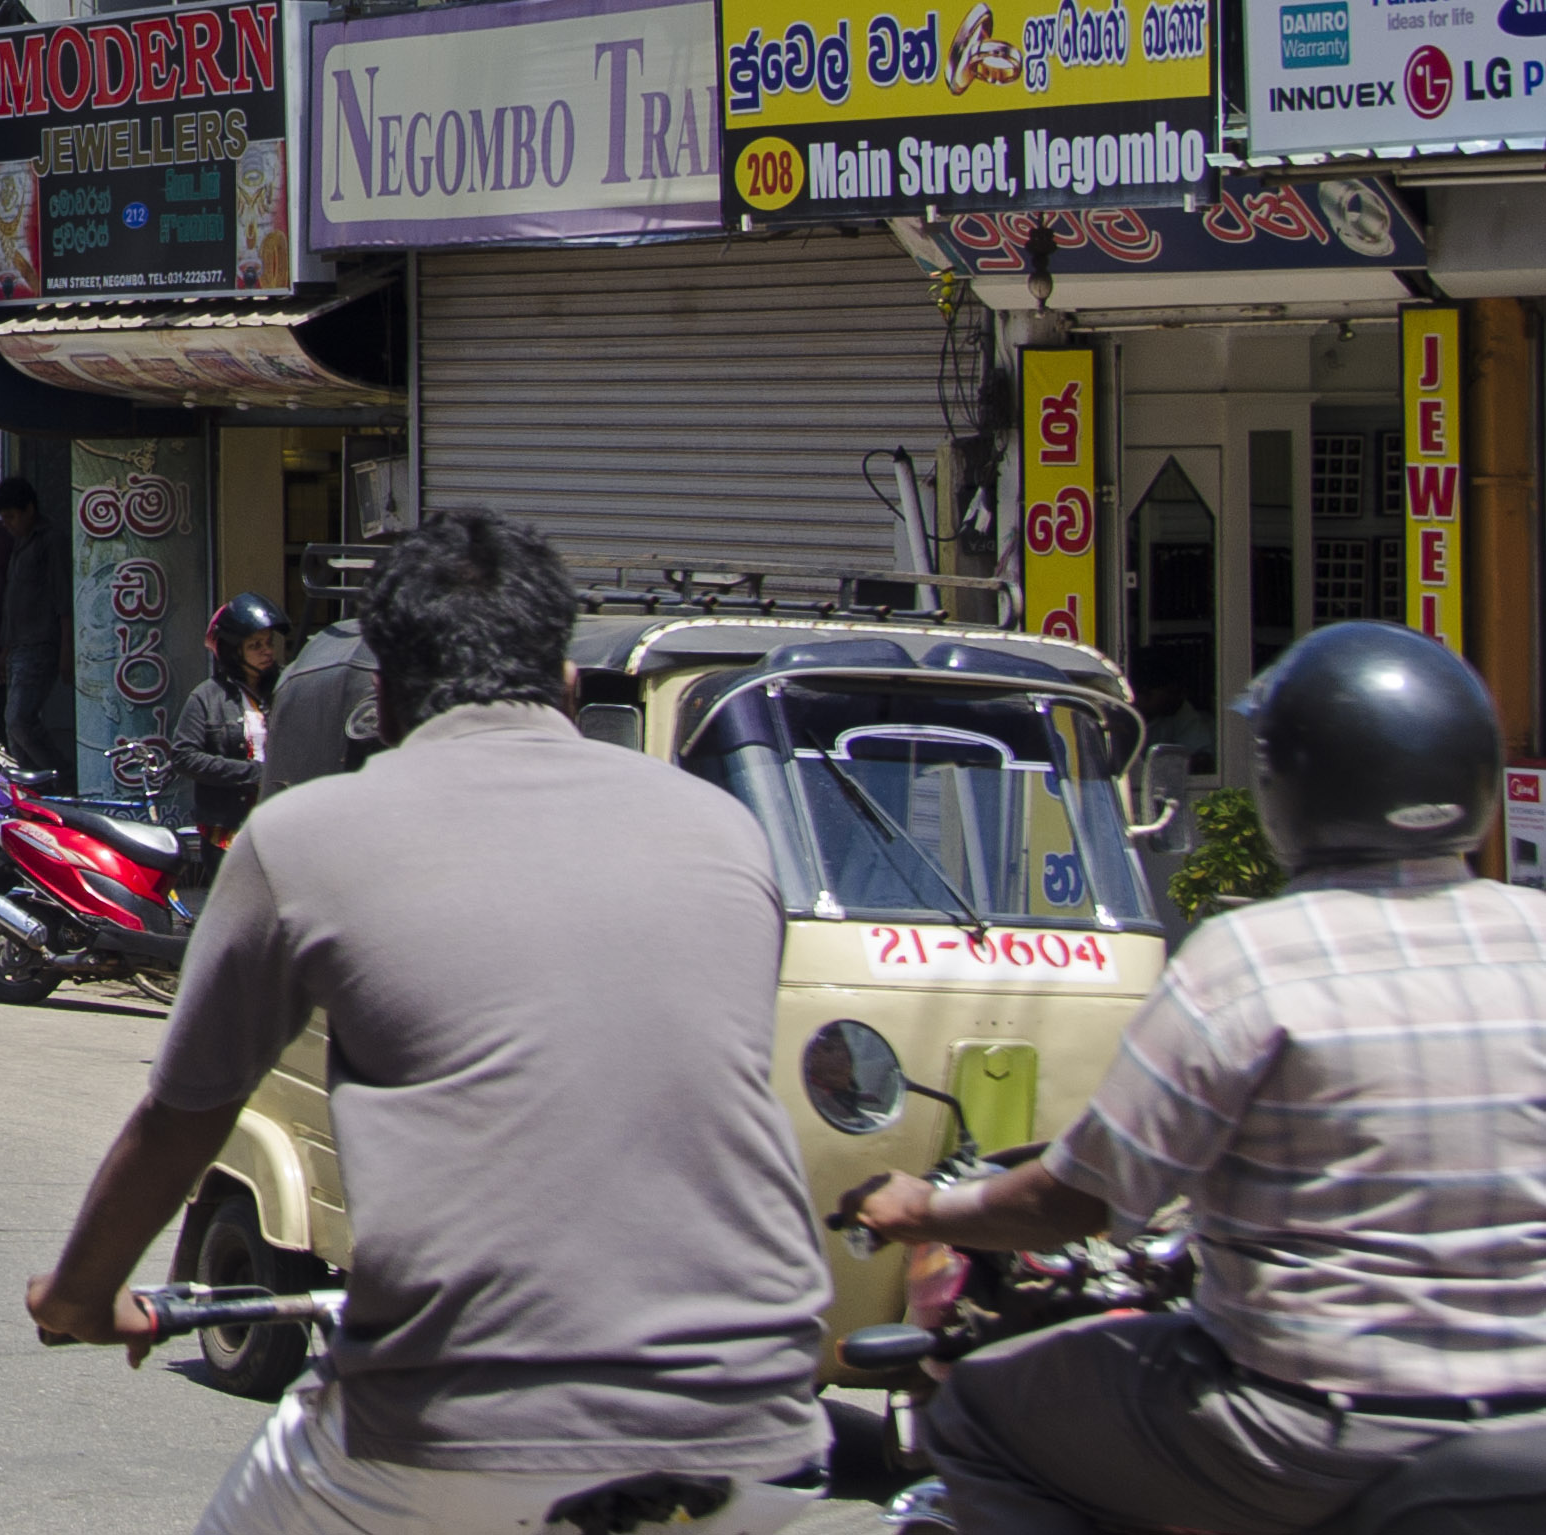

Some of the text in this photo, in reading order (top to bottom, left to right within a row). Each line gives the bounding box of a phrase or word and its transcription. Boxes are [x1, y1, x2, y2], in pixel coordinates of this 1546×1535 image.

[1282, 11, 1347, 35] DAMRO
[1387, 7, 1475, 31] ideas for life
[1282, 37, 1349, 60] Warranty
[1464, 56, 1513, 102] LG
[1269, 80, 1396, 113] INNOVEX
[31, 108, 249, 178] JEWELLERS
[747, 149, 794, 197] 208
[809, 121, 1206, 200] Main Street, Negombo
[125, 207, 146, 223] 212
[47, 274, 147, 290] MAIN STREET, NEGOMBO.
